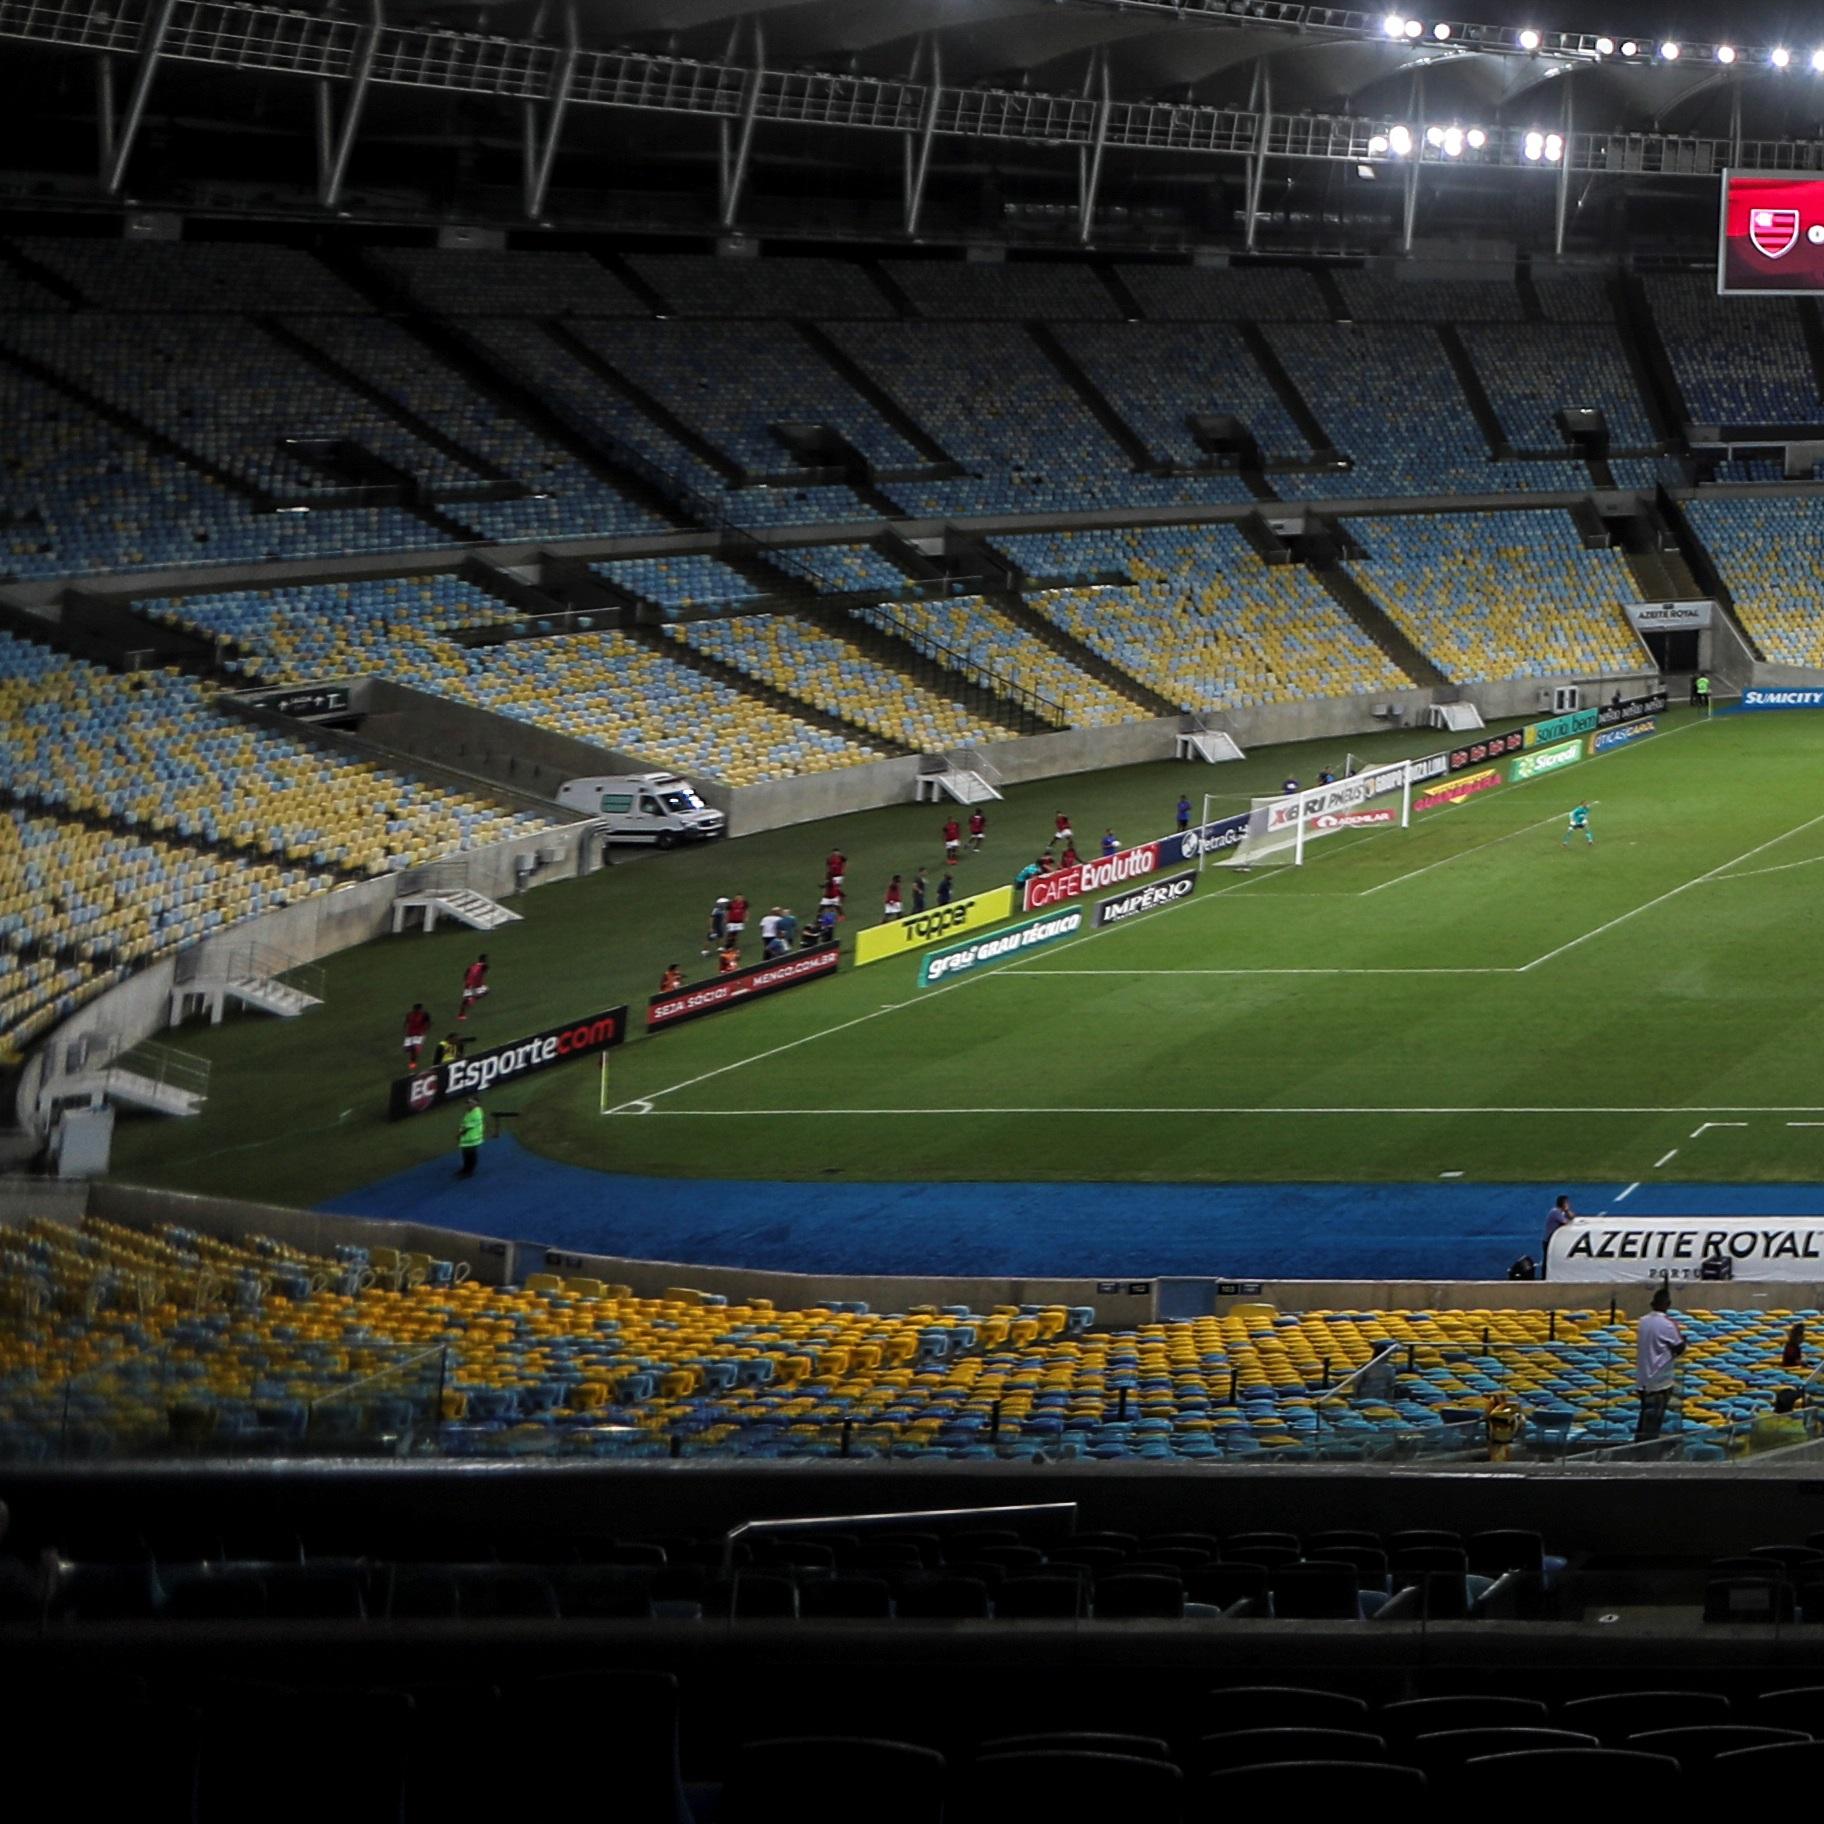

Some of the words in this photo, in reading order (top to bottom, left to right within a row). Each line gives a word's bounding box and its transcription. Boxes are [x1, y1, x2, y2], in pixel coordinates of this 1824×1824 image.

[1639, 610, 1669, 619] AZEITE
[1670, 609, 1699, 618] ROYAL
[1745, 690, 1824, 705] SUMICITY
[1030, 870, 1081, 908] CAFÉ
[1080, 843, 1155, 893] Evolutto
[410, 1074, 439, 1102] EC
[1568, 1231, 1698, 1259] AZEITE
[1701, 1230, 1824, 1259] ROYAL
[1649, 1268, 1703, 1280] PORTU
